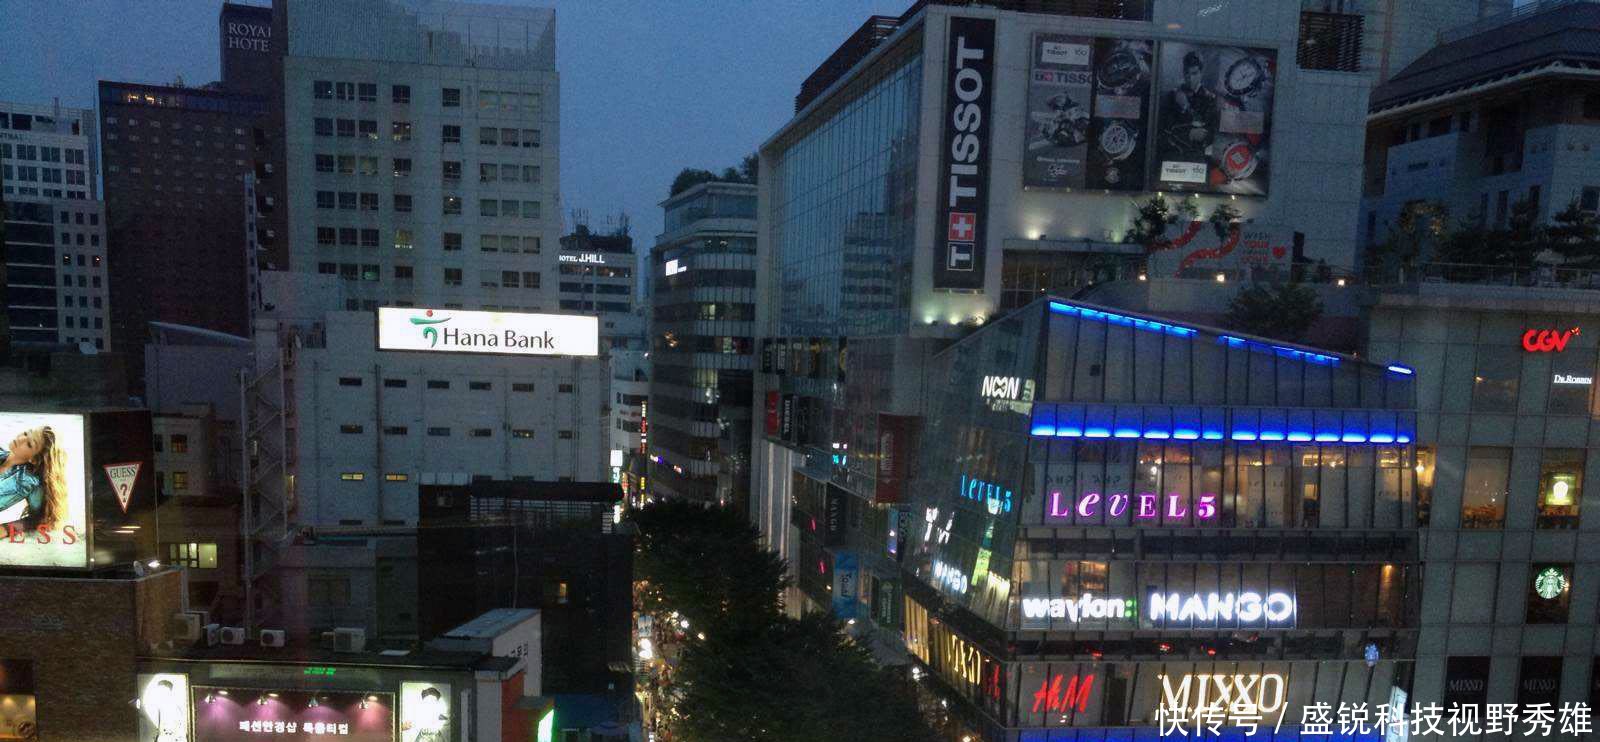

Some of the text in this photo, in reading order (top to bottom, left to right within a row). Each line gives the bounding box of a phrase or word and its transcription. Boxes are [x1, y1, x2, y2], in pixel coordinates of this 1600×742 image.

[950, 36, 984, 208] TISSOT
[443, 328, 555, 349] Hana Bank
[1523, 328, 1571, 352] CGV
[110, 467, 137, 479] GUESS
[0, 521, 77, 545] ESS
[1150, 592, 1295, 621] MANGO
[1157, 673, 1284, 714] MIXXO
